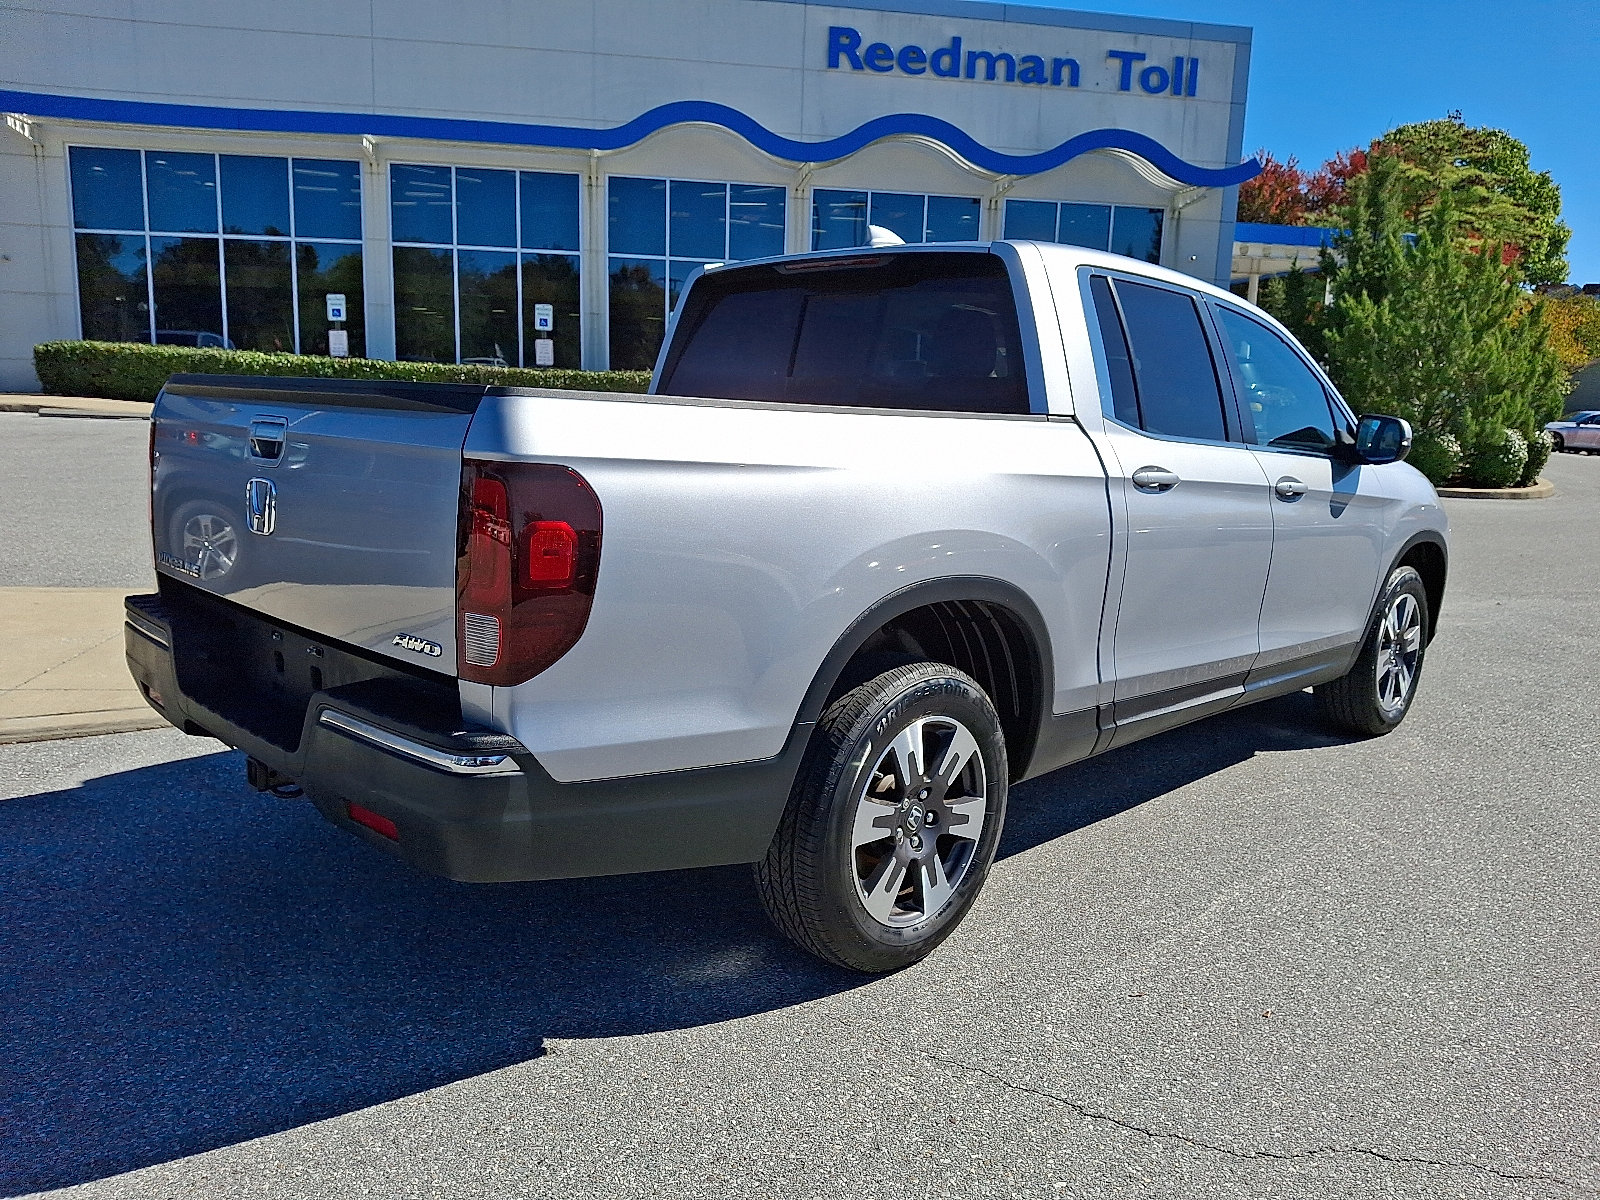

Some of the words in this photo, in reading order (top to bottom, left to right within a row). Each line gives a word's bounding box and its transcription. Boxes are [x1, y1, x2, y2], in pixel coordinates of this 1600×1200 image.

[827, 26, 1080, 87] Reedman
[1109, 50, 1200, 96] Toll
[392, 634, 442, 657] AWD
